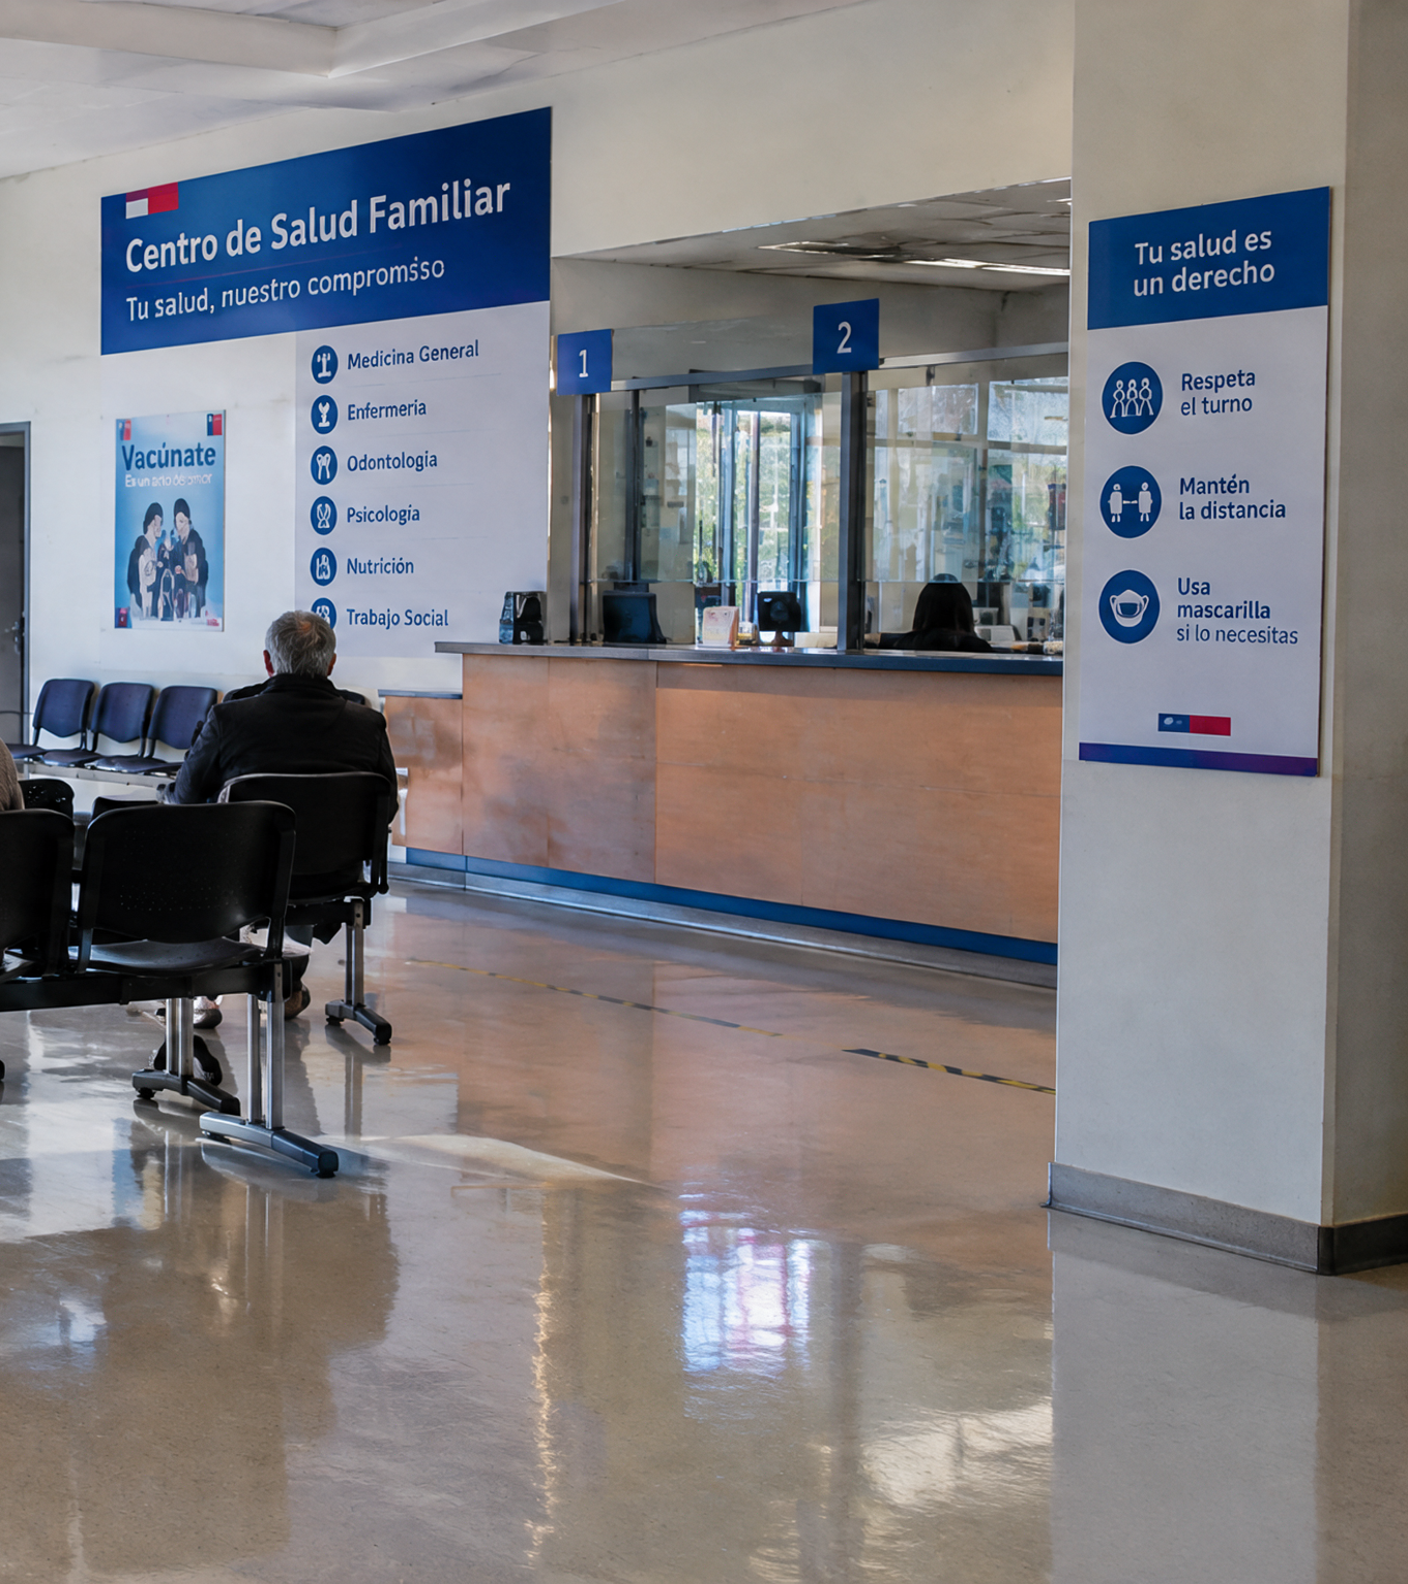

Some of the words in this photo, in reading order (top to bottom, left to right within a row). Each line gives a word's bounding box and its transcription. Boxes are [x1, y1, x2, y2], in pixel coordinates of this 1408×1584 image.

[126, 232, 218, 272] Centro
[226, 219, 261, 256] de
[271, 200, 357, 249] Salud
[369, 178, 511, 233] Familiar
[1134, 242, 1163, 265] Tu
[1170, 229, 1237, 261] salud
[1244, 231, 1272, 251] es
[1134, 277, 1164, 297] un
[1172, 260, 1275, 292] derecho
[127, 296, 149, 321] Tu
[154, 288, 215, 318] salud,
[221, 279, 300, 307] nuestro
[836, 321, 852, 354] 2
[347, 349, 414, 370] Medicina
[419, 339, 479, 362] General
[579, 348, 589, 378] 1
[1181, 369, 1256, 393] Respeta
[1180, 397, 1196, 416] el
[1201, 397, 1253, 415] turno
[122, 441, 216, 471] Vacúnate
[1180, 473, 1250, 495] Mantén
[1179, 501, 1195, 520] la
[1200, 499, 1286, 520] distancia
[347, 557, 414, 575] Nutrición
[1177, 577, 1211, 596] Usa
[346, 608, 401, 630] Trabajo
[404, 608, 449, 626] Social
[1177, 600, 1271, 619] mascarilla
[1176, 624, 1190, 642] si
[1195, 624, 1211, 642] lo
[1215, 626, 1298, 645] necesitas
